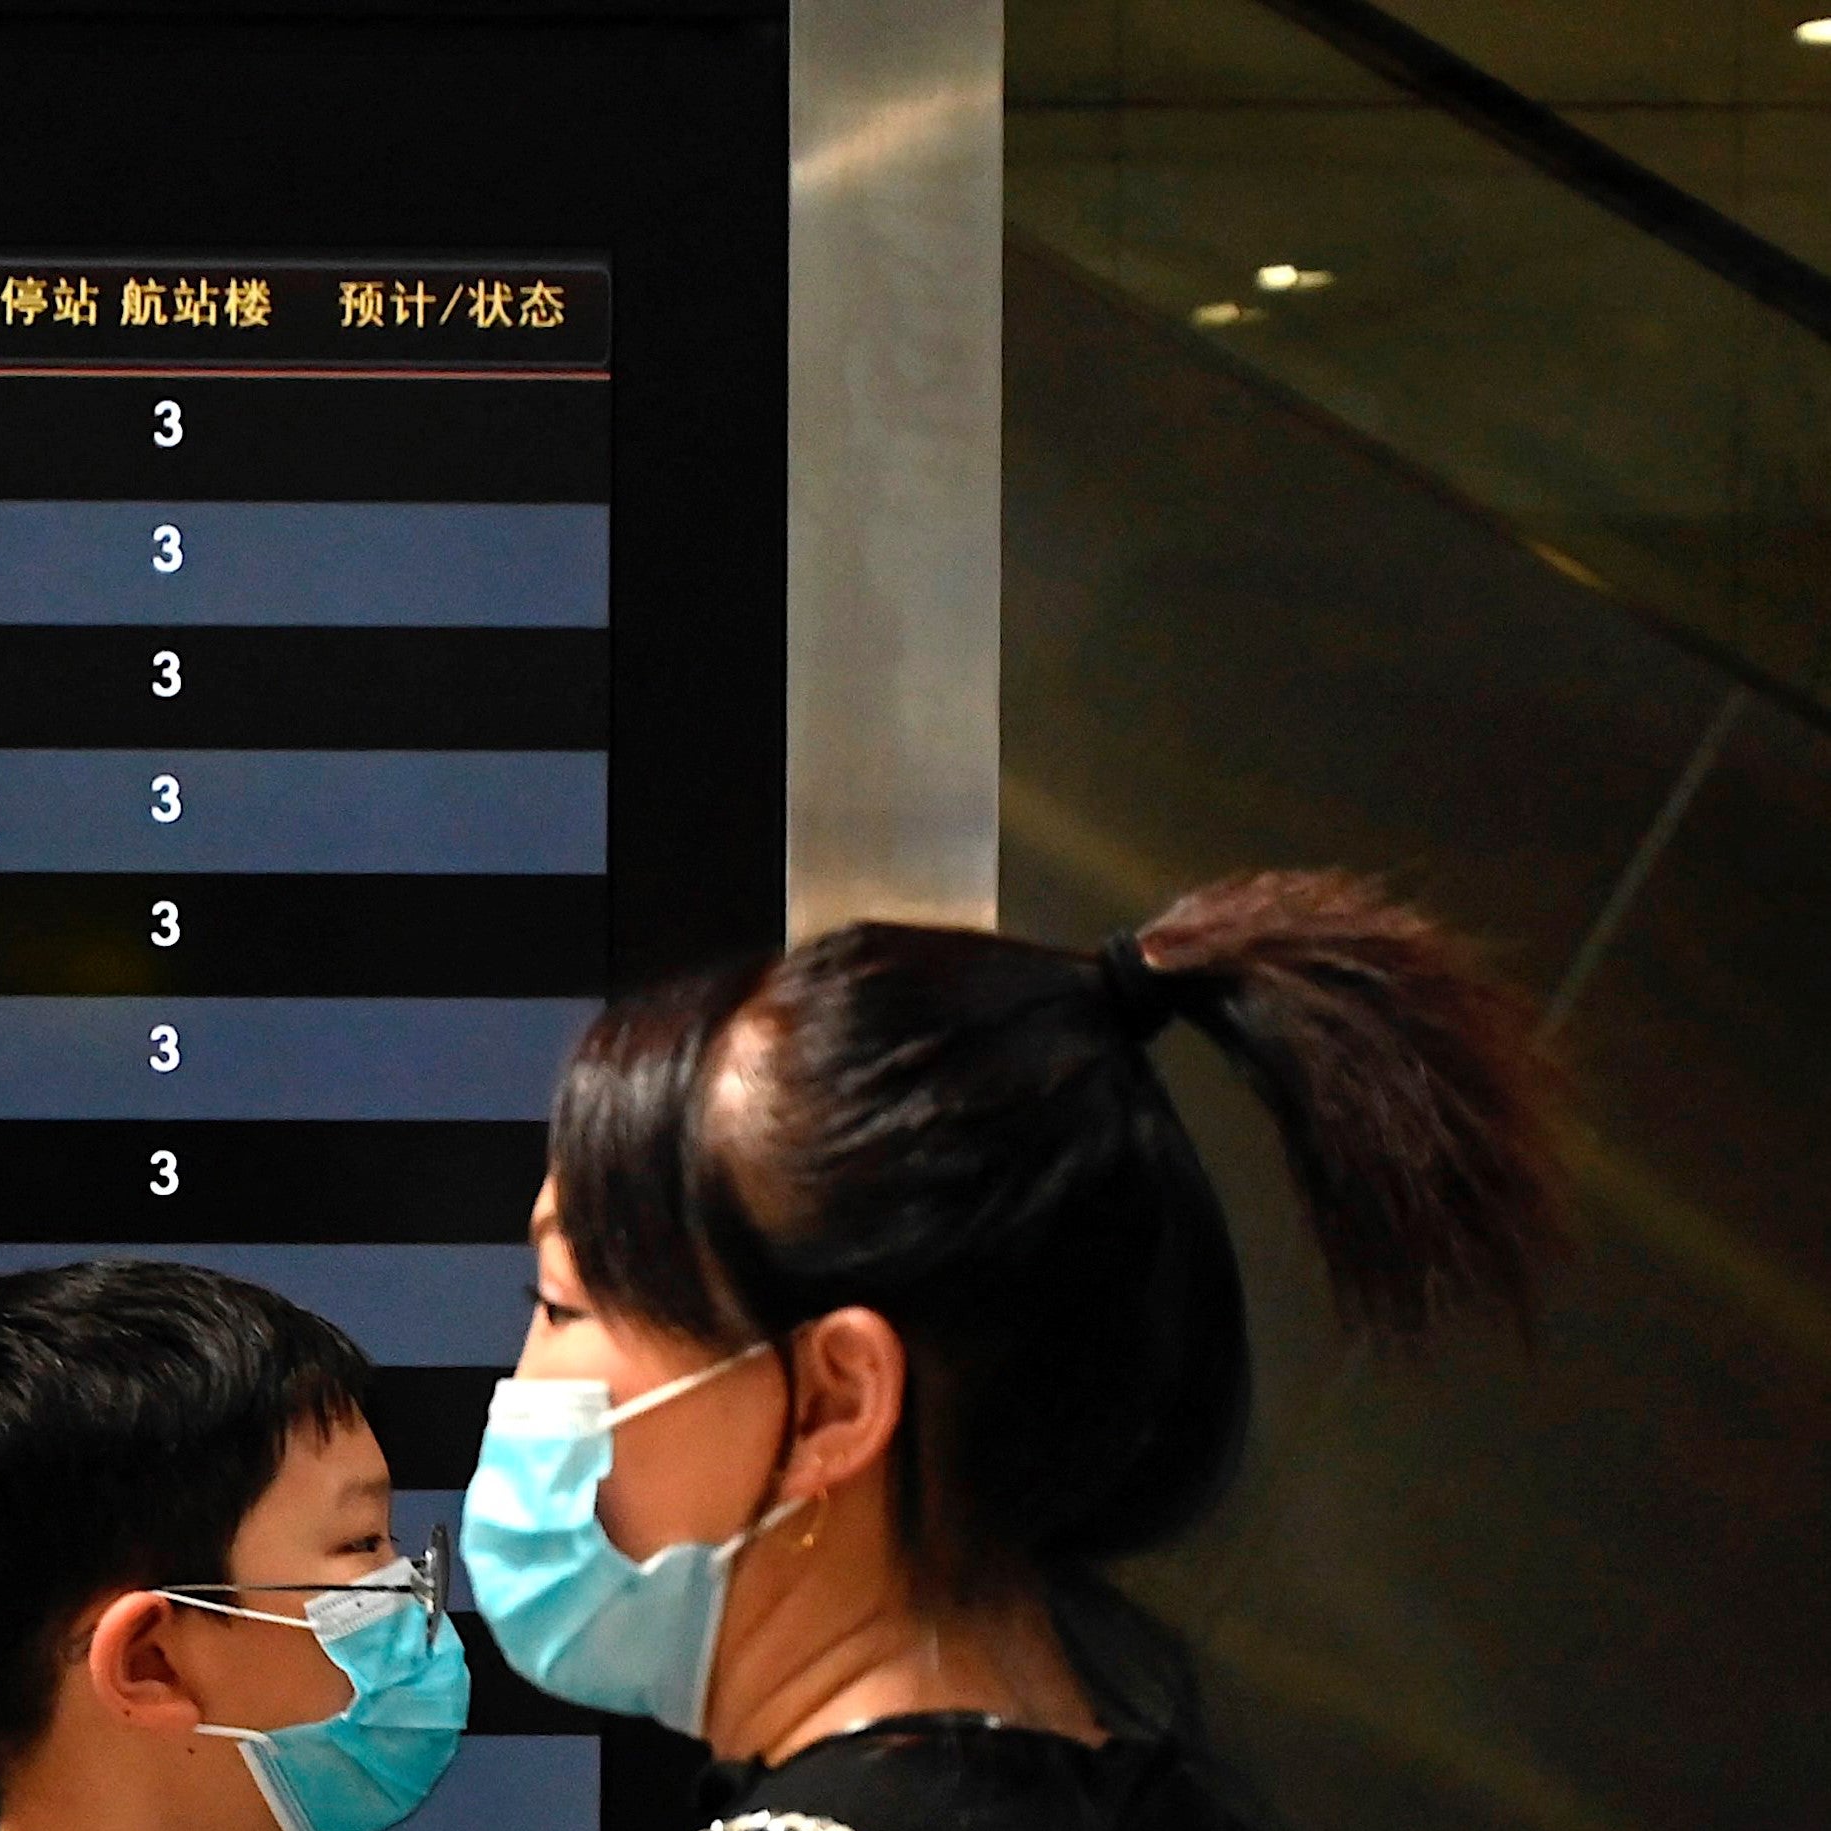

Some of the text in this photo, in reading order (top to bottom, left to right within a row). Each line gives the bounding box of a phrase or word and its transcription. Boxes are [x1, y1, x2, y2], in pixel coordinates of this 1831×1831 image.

[120, 277, 272, 328] 航站楼
[340, 280, 565, 329] 预计/状态
[152, 399, 184, 448] 3
[151, 523, 184, 574] 3
[151, 650, 183, 698] 3
[150, 774, 183, 824] 3
[150, 899, 182, 948] 3
[148, 1023, 181, 1073] 3
[148, 1149, 180, 1197] 3
